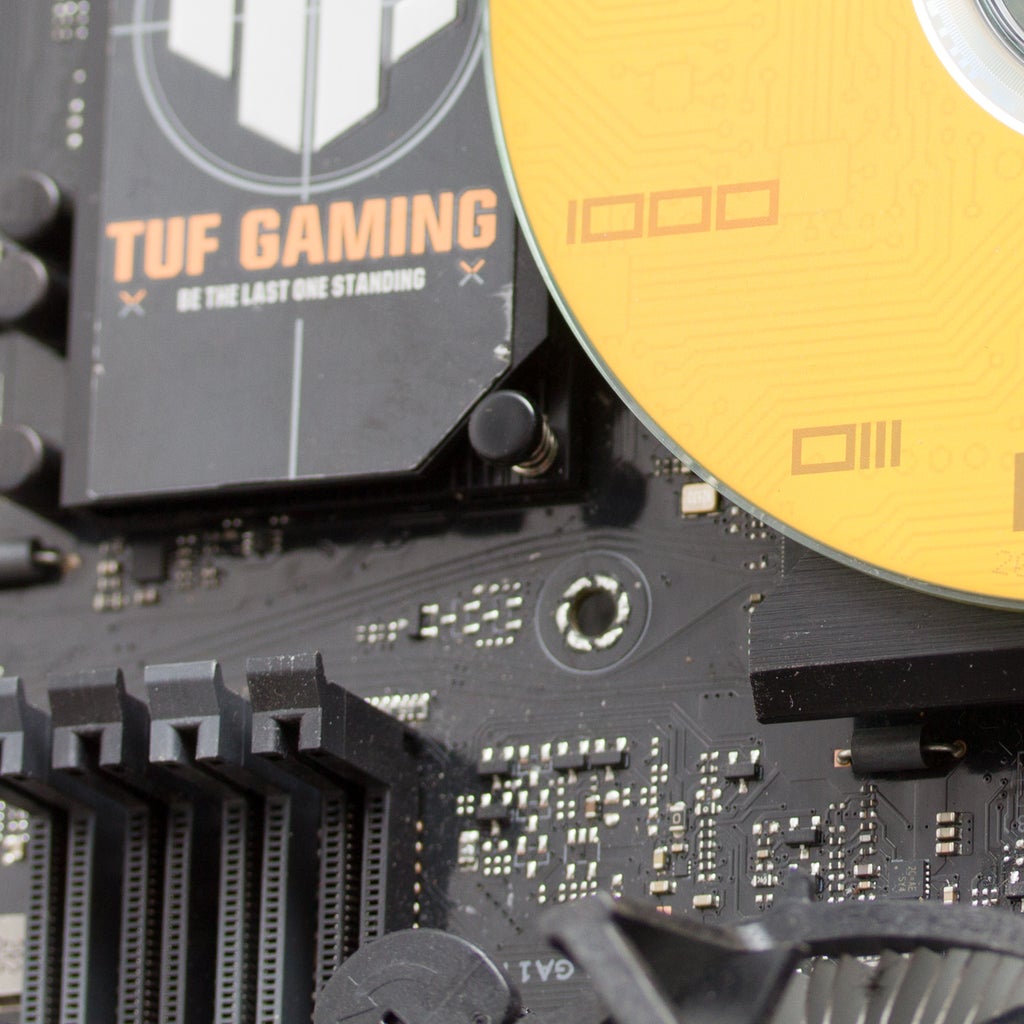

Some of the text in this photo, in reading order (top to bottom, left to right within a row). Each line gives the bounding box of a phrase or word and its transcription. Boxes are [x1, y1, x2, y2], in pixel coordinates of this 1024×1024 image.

[106, 188, 498, 283] TUF GAMING
[177, 267, 426, 313] BE THE LAST ONE STANDING
[503, 958, 575, 983] GA1
